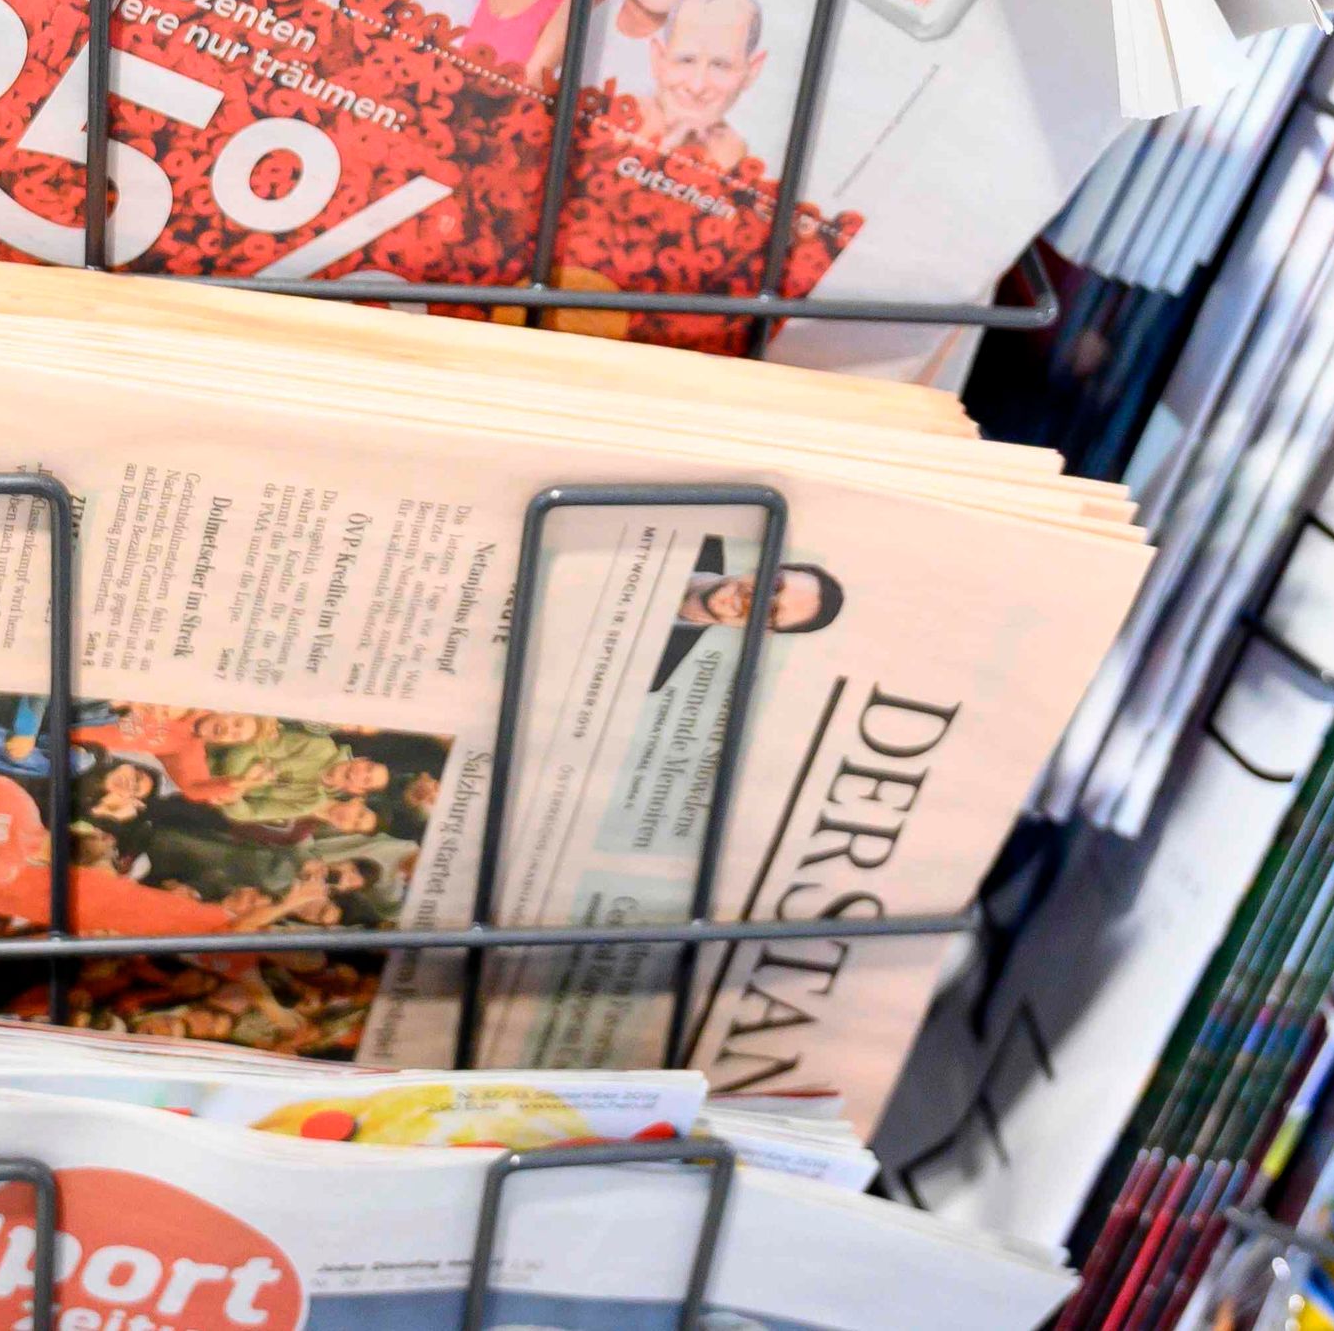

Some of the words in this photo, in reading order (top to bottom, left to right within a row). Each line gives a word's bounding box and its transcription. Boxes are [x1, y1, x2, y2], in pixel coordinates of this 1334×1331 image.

[183, 23, 248, 63] nur
[251, 48, 406, 133] träumen:
[616, 154, 736, 223] Gutschein
[123, 462, 138, 481] am
[262, 482, 278, 498] de
[106, 483, 136, 535] Dienstag
[134, 465, 159, 522] schlechte
[150, 468, 181, 540] Nachwuchs.
[274, 484, 296, 527] nimmt
[291, 487, 315, 539] währten
[319, 489, 337, 512] Die
[396, 498, 414, 518] für
[253, 502, 273, 532] FMA
[403, 500, 433, 560] Benjamin
[428, 503, 449, 543] nutzte
[453, 504, 471, 526] Die
[115, 524, 146, 589] Bezahlung,
[145, 543, 162, 563] Ein
[155, 472, 201, 600] Gerichtsdolmetschern
[190, 496, 231, 588] Dolmetscher
[244, 535, 261, 567] unter
[269, 530, 286, 550] die
[301, 516, 327, 575] angeblich
[437, 533, 462, 576] letzten
[91, 536, 121, 614] protestierten.
[237, 569, 254, 589] die
[276, 548, 301, 593] Kredite
[323, 511, 372, 608] ÖVP-Kredite
[419, 551, 436, 572] der
[620, 525, 656, 608] MITTWOCH,
[9, 584, 26, 612] wird
[135, 563, 158, 603] Grund
[184, 590, 203, 611] im
[293, 580, 309, 602] von
[383, 563, 413, 625] Netanjahu
[453, 542, 496, 624] Netanjahus
[108, 592, 127, 627] gegen
[127, 603, 148, 636] dafür
[148, 606, 167, 633] fehlt
[227, 590, 249, 624] Lupe.
[268, 602, 286, 620] für
[316, 609, 334, 628] im
[2, 614, 21, 649] heute
[83, 631, 101, 657] Seite
[172, 613, 199, 658] Streik
[261, 629, 277, 649] die
[275, 607, 304, 665] Raiffeisen
[436, 625, 468, 674] Kampf
[216, 647, 233, 672] Seite
[251, 657, 273, 685] ÖVP
[304, 632, 331, 674] Visier
[583, 630, 619, 707] SEPTEMBER
[670, 649, 723, 751] spannende
[572, 709, 592, 739] 2019
[441, 750, 495, 835] Salzburg
[632, 757, 688, 850] Memoiren
[426, 838, 458, 895] startet
